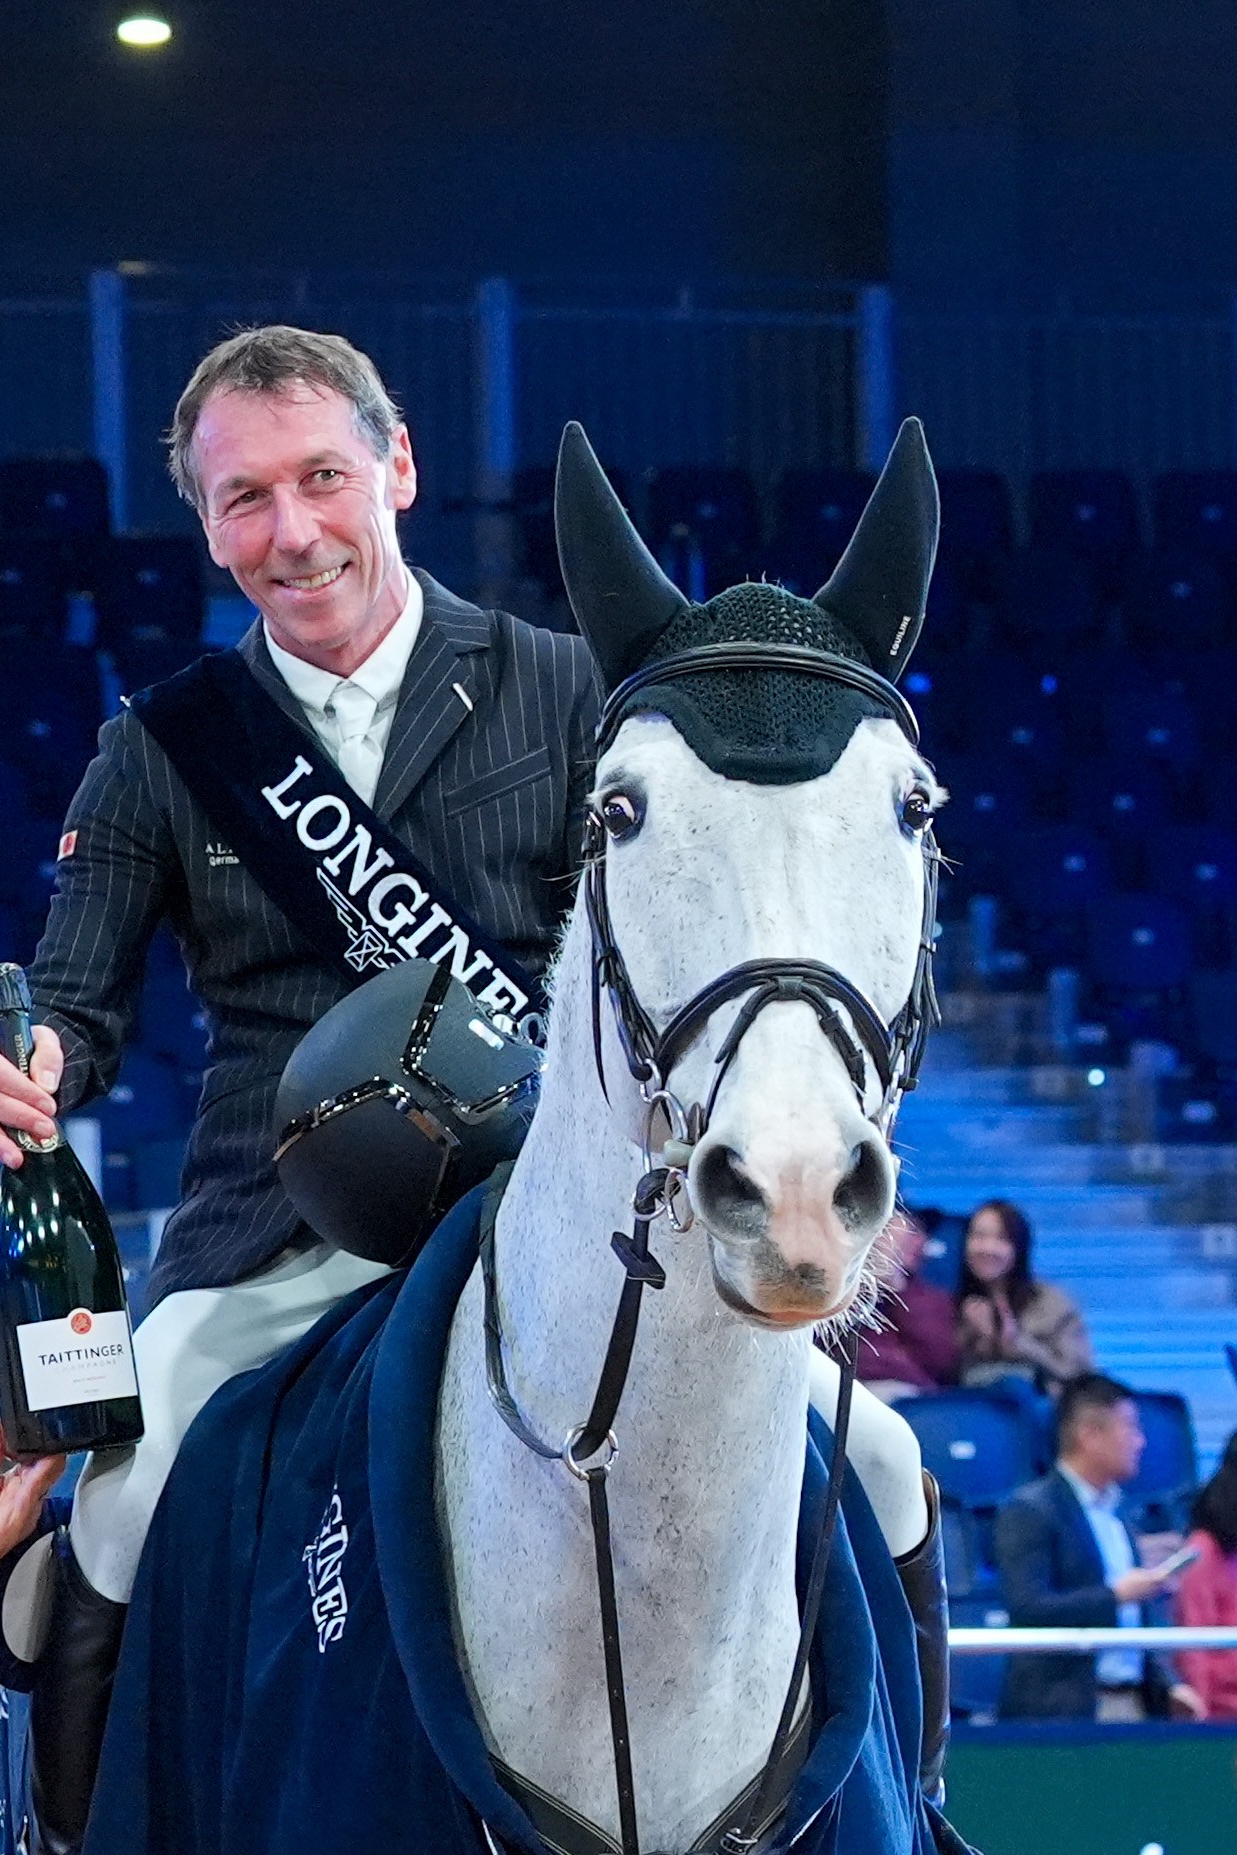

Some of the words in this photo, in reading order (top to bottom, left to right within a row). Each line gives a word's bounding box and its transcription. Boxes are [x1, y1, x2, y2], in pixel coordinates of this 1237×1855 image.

[261, 755, 529, 1017] LONGINE
[14, 1032, 29, 1077] TINGER
[38, 1343, 124, 1366] TAITTINGER
[312, 1484, 349, 1654] GINES
